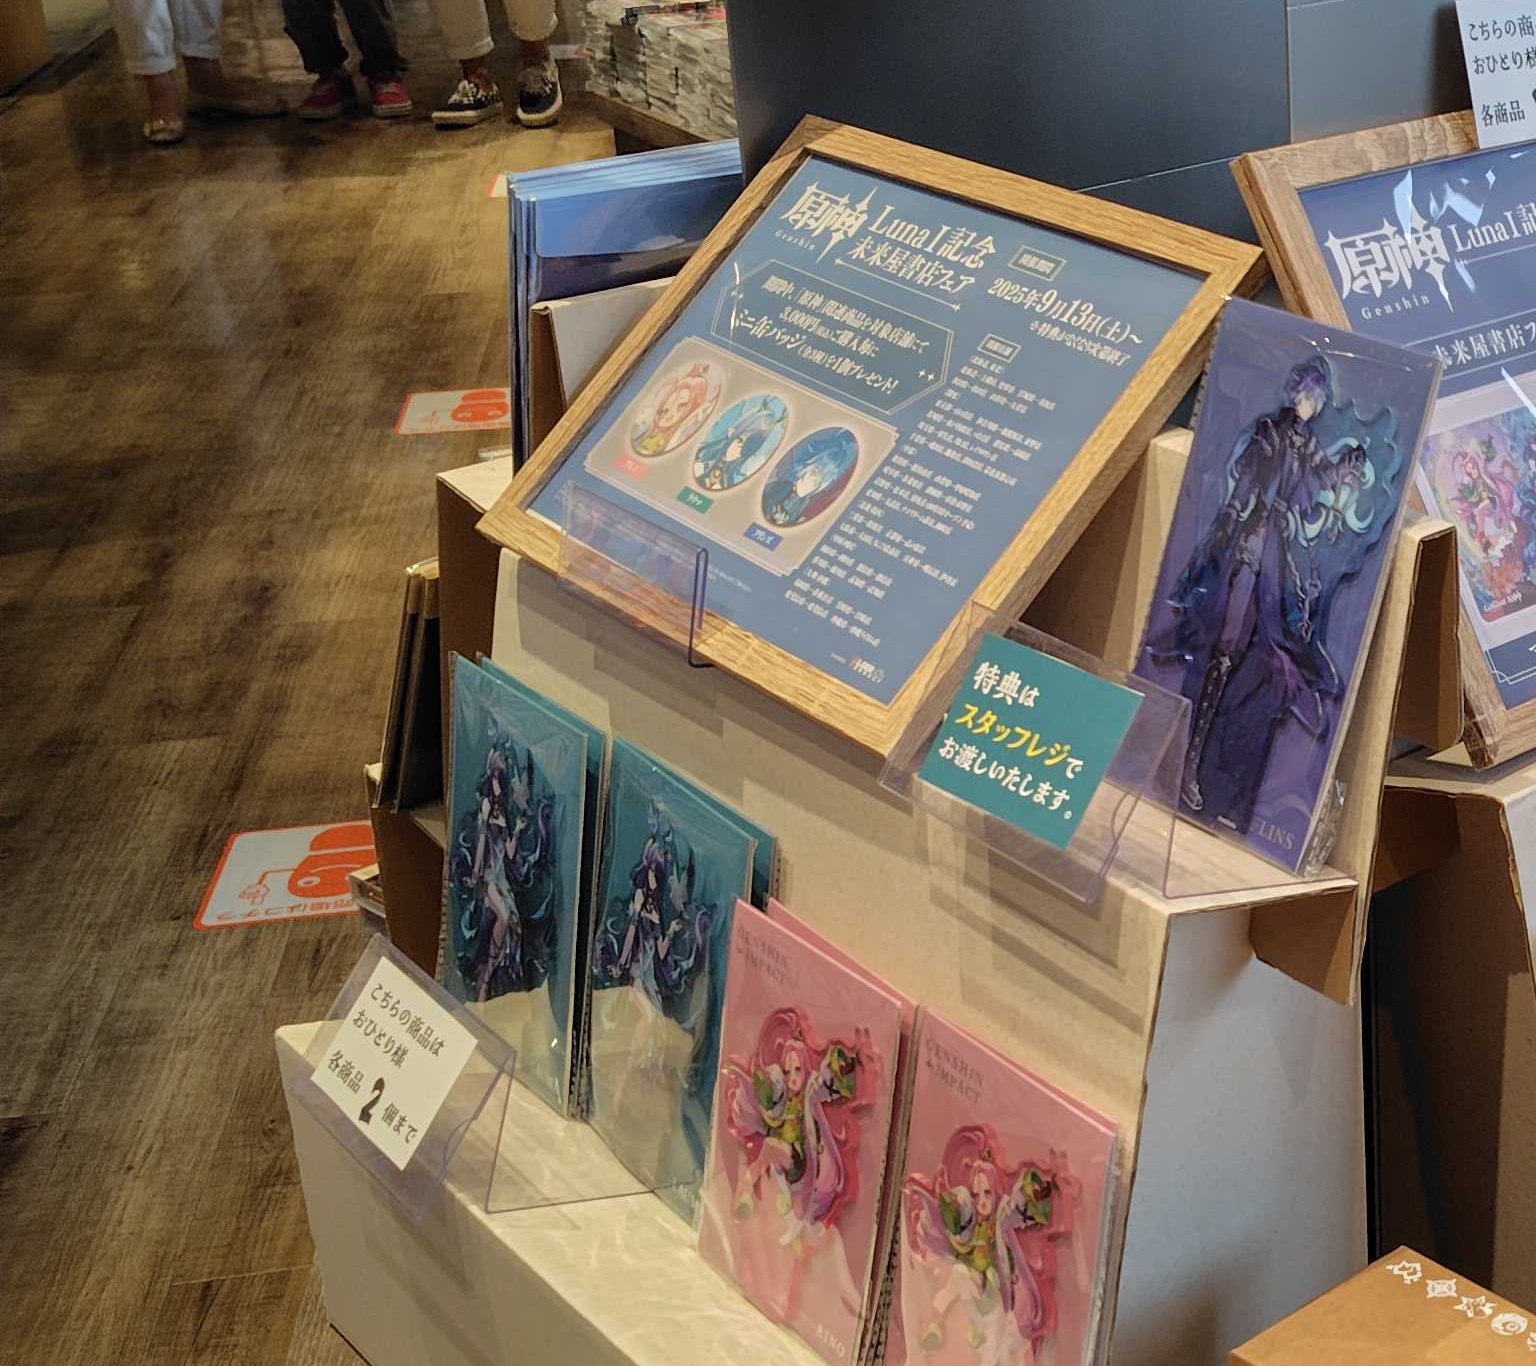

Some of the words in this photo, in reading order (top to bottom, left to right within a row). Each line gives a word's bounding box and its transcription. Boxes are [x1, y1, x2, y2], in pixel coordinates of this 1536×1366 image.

[1481, 100, 1525, 128] 各商品
[780, 184, 880, 264] 原神
[847, 236, 976, 295] 未来屋書店フェア
[1324, 206, 1455, 313] 原神
[1360, 292, 1431, 322] Genshin
[973, 661, 1040, 707] 特典は
[954, 702, 1084, 779] スタッフレジで
[351, 1008, 410, 1069] おひとり様
[369, 982, 446, 1058] こちらの商品は
[925, 1038, 986, 1088] GENSHIN
[933, 1060, 982, 1104] IMPACT
[326, 1049, 365, 1095] 各商品
[358, 1077, 386, 1125] 2
[381, 1102, 419, 1144] 個まで
[814, 1322, 847, 1360] AINO
